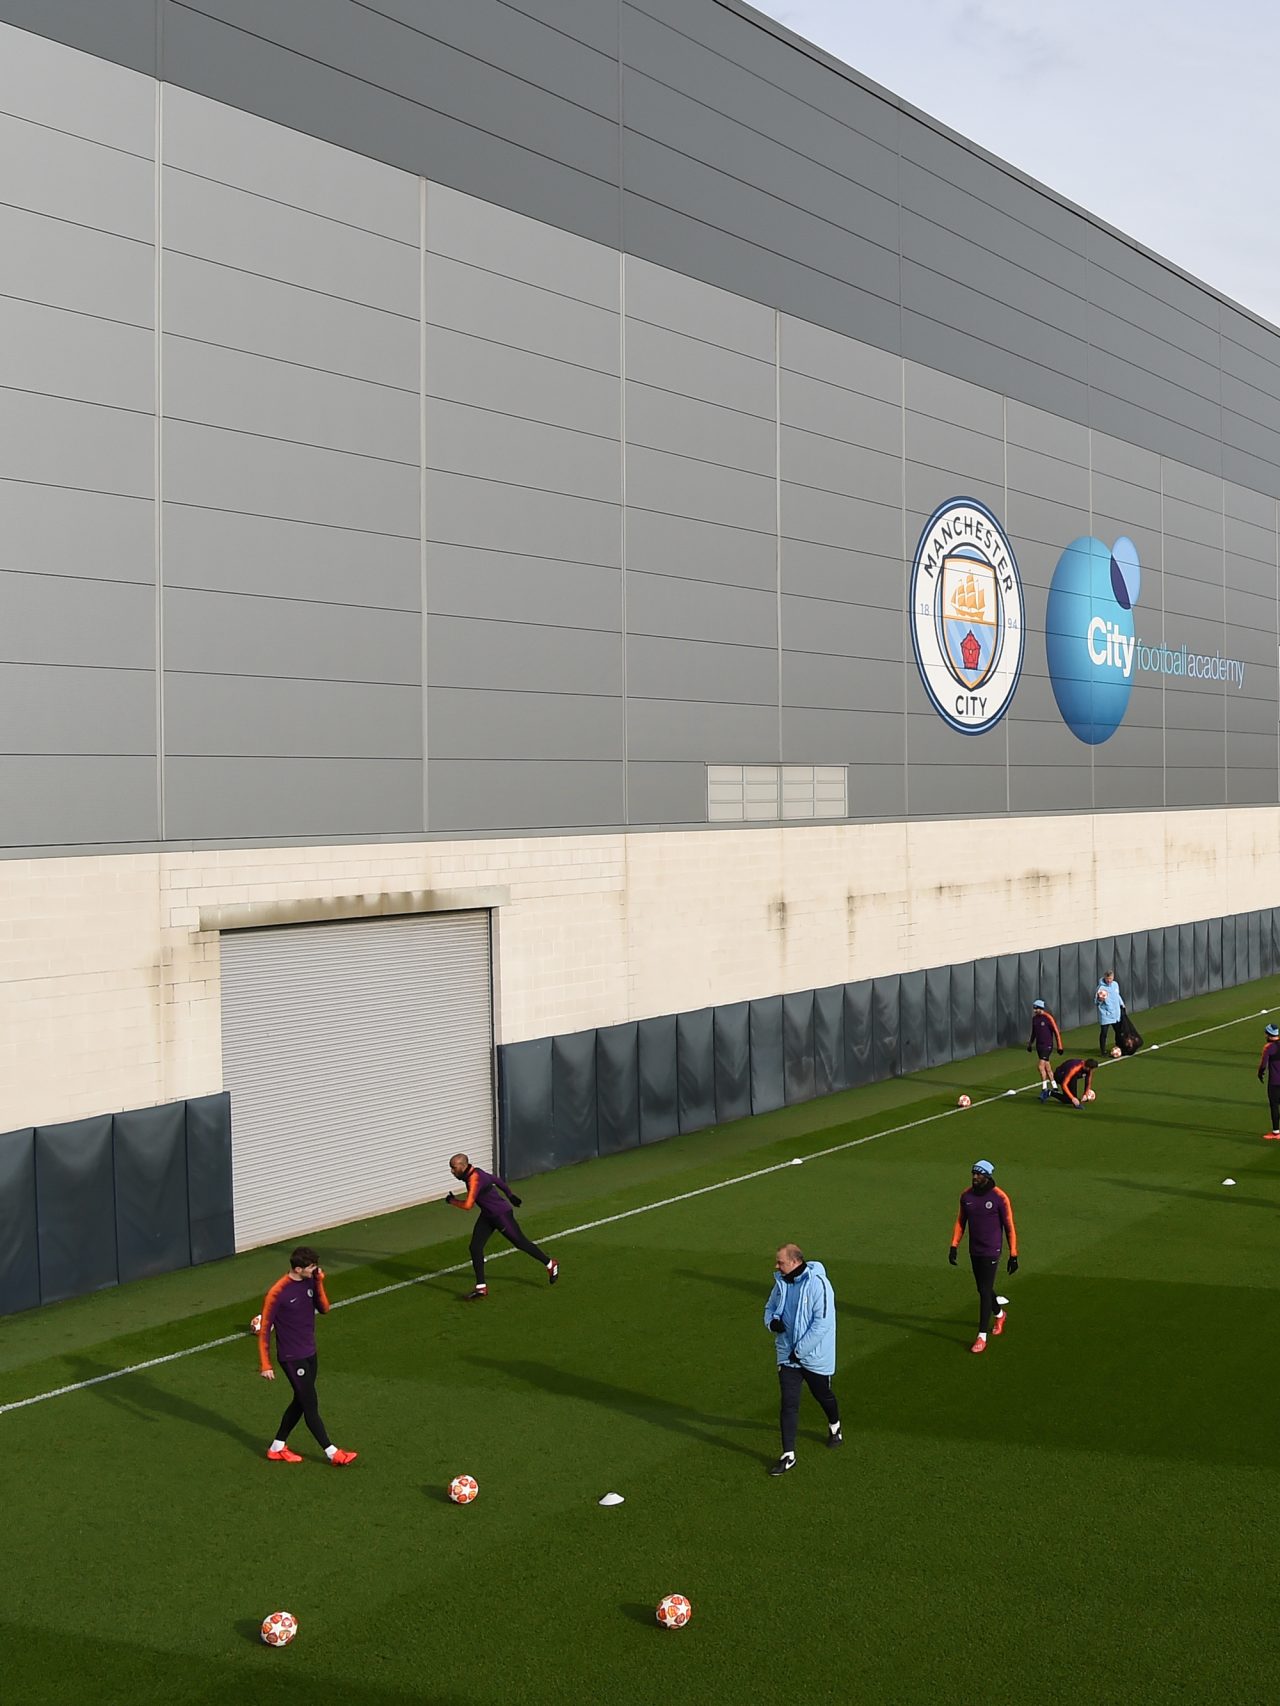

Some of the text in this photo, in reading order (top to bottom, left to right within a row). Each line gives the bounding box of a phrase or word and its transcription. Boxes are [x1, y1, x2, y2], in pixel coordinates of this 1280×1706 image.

[924, 515, 1013, 594] MANCHESTER
[920, 602, 1018, 630] 18 94
[1087, 616, 1135, 678] City
[955, 695, 988, 717] CITY
